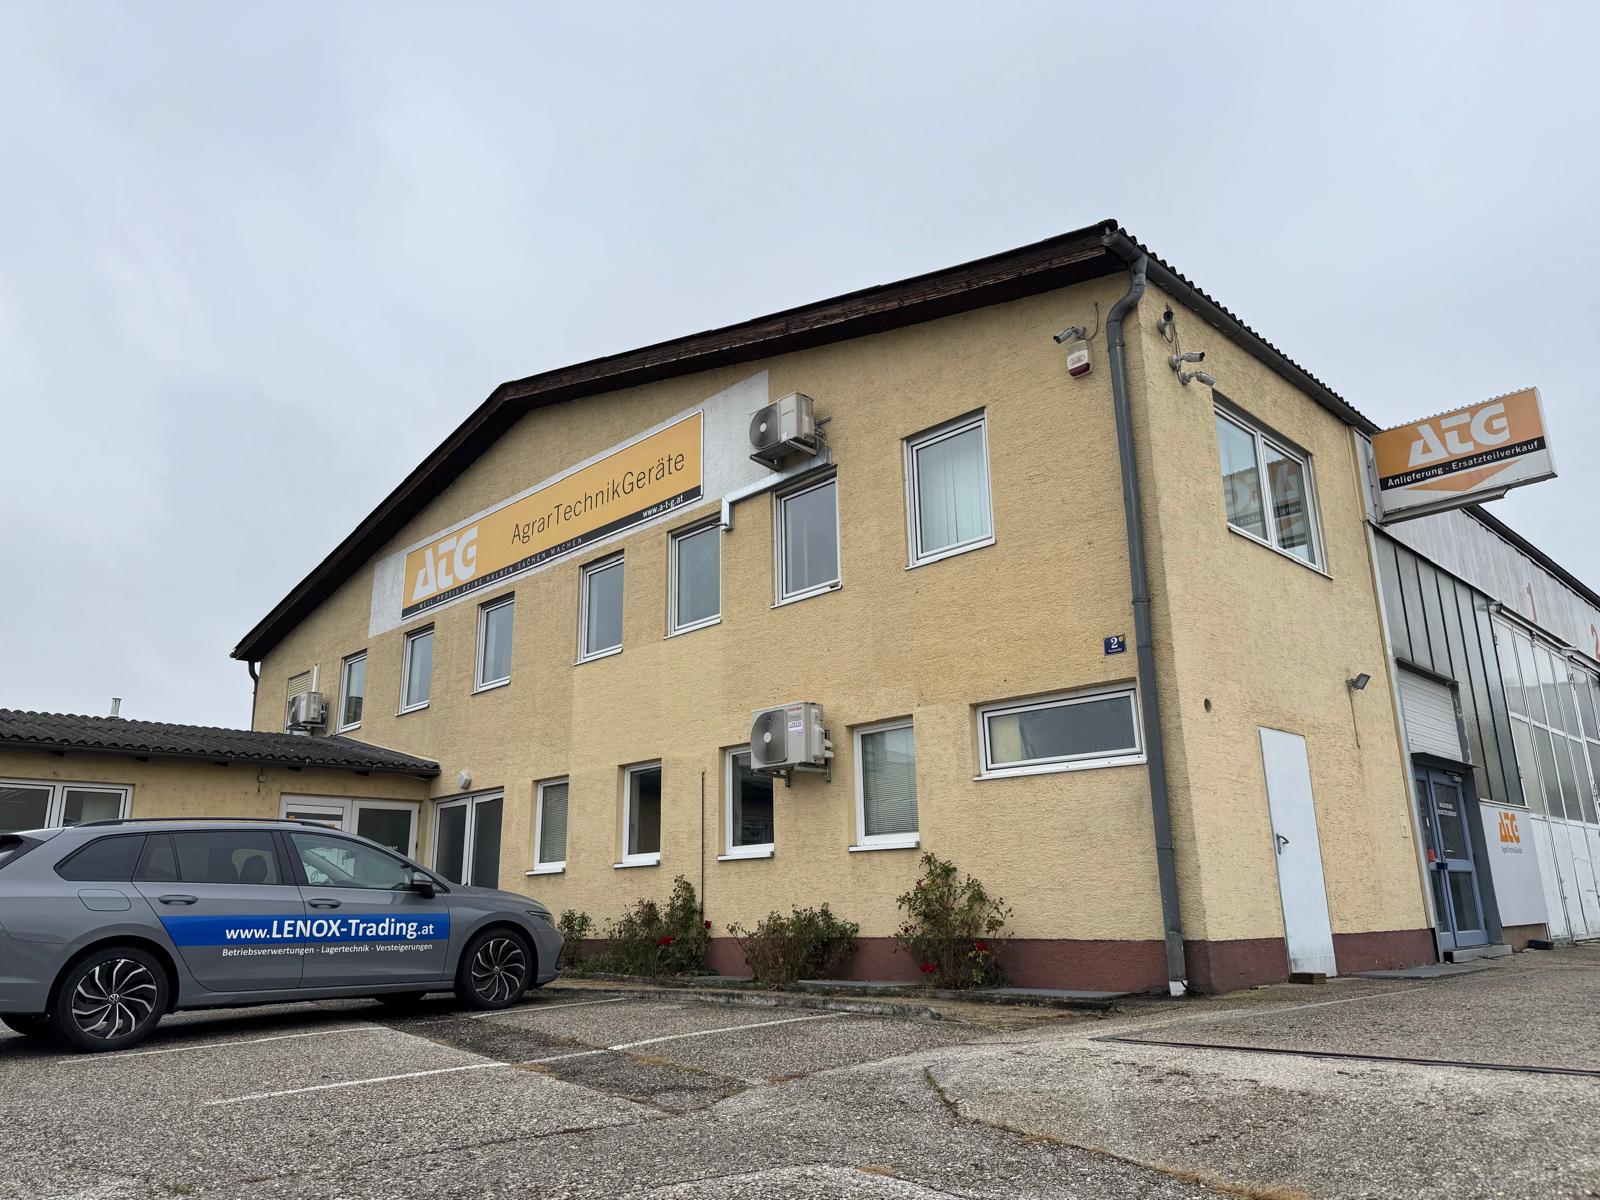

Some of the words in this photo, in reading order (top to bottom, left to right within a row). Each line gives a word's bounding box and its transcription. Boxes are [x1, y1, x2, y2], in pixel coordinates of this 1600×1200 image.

[1387, 465, 1444, 487] Anlieferung
[1451, 440, 1539, 470] Ersatzteilverkauf
[512, 453, 685, 544] AgrarTechnikGeräte
[642, 494, 684, 518] www.a-t-g.at
[517, 553, 546, 570] SACHEN
[550, 538, 582, 555] MACHEN
[1110, 637, 1118, 649] 2
[225, 917, 434, 940] www.LENOX-Trading.at
[222, 946, 315, 957] Betriebsverwertungen
[321, 944, 370, 955] Lagertechnik
[375, 943, 433, 953] Versteigerungen
